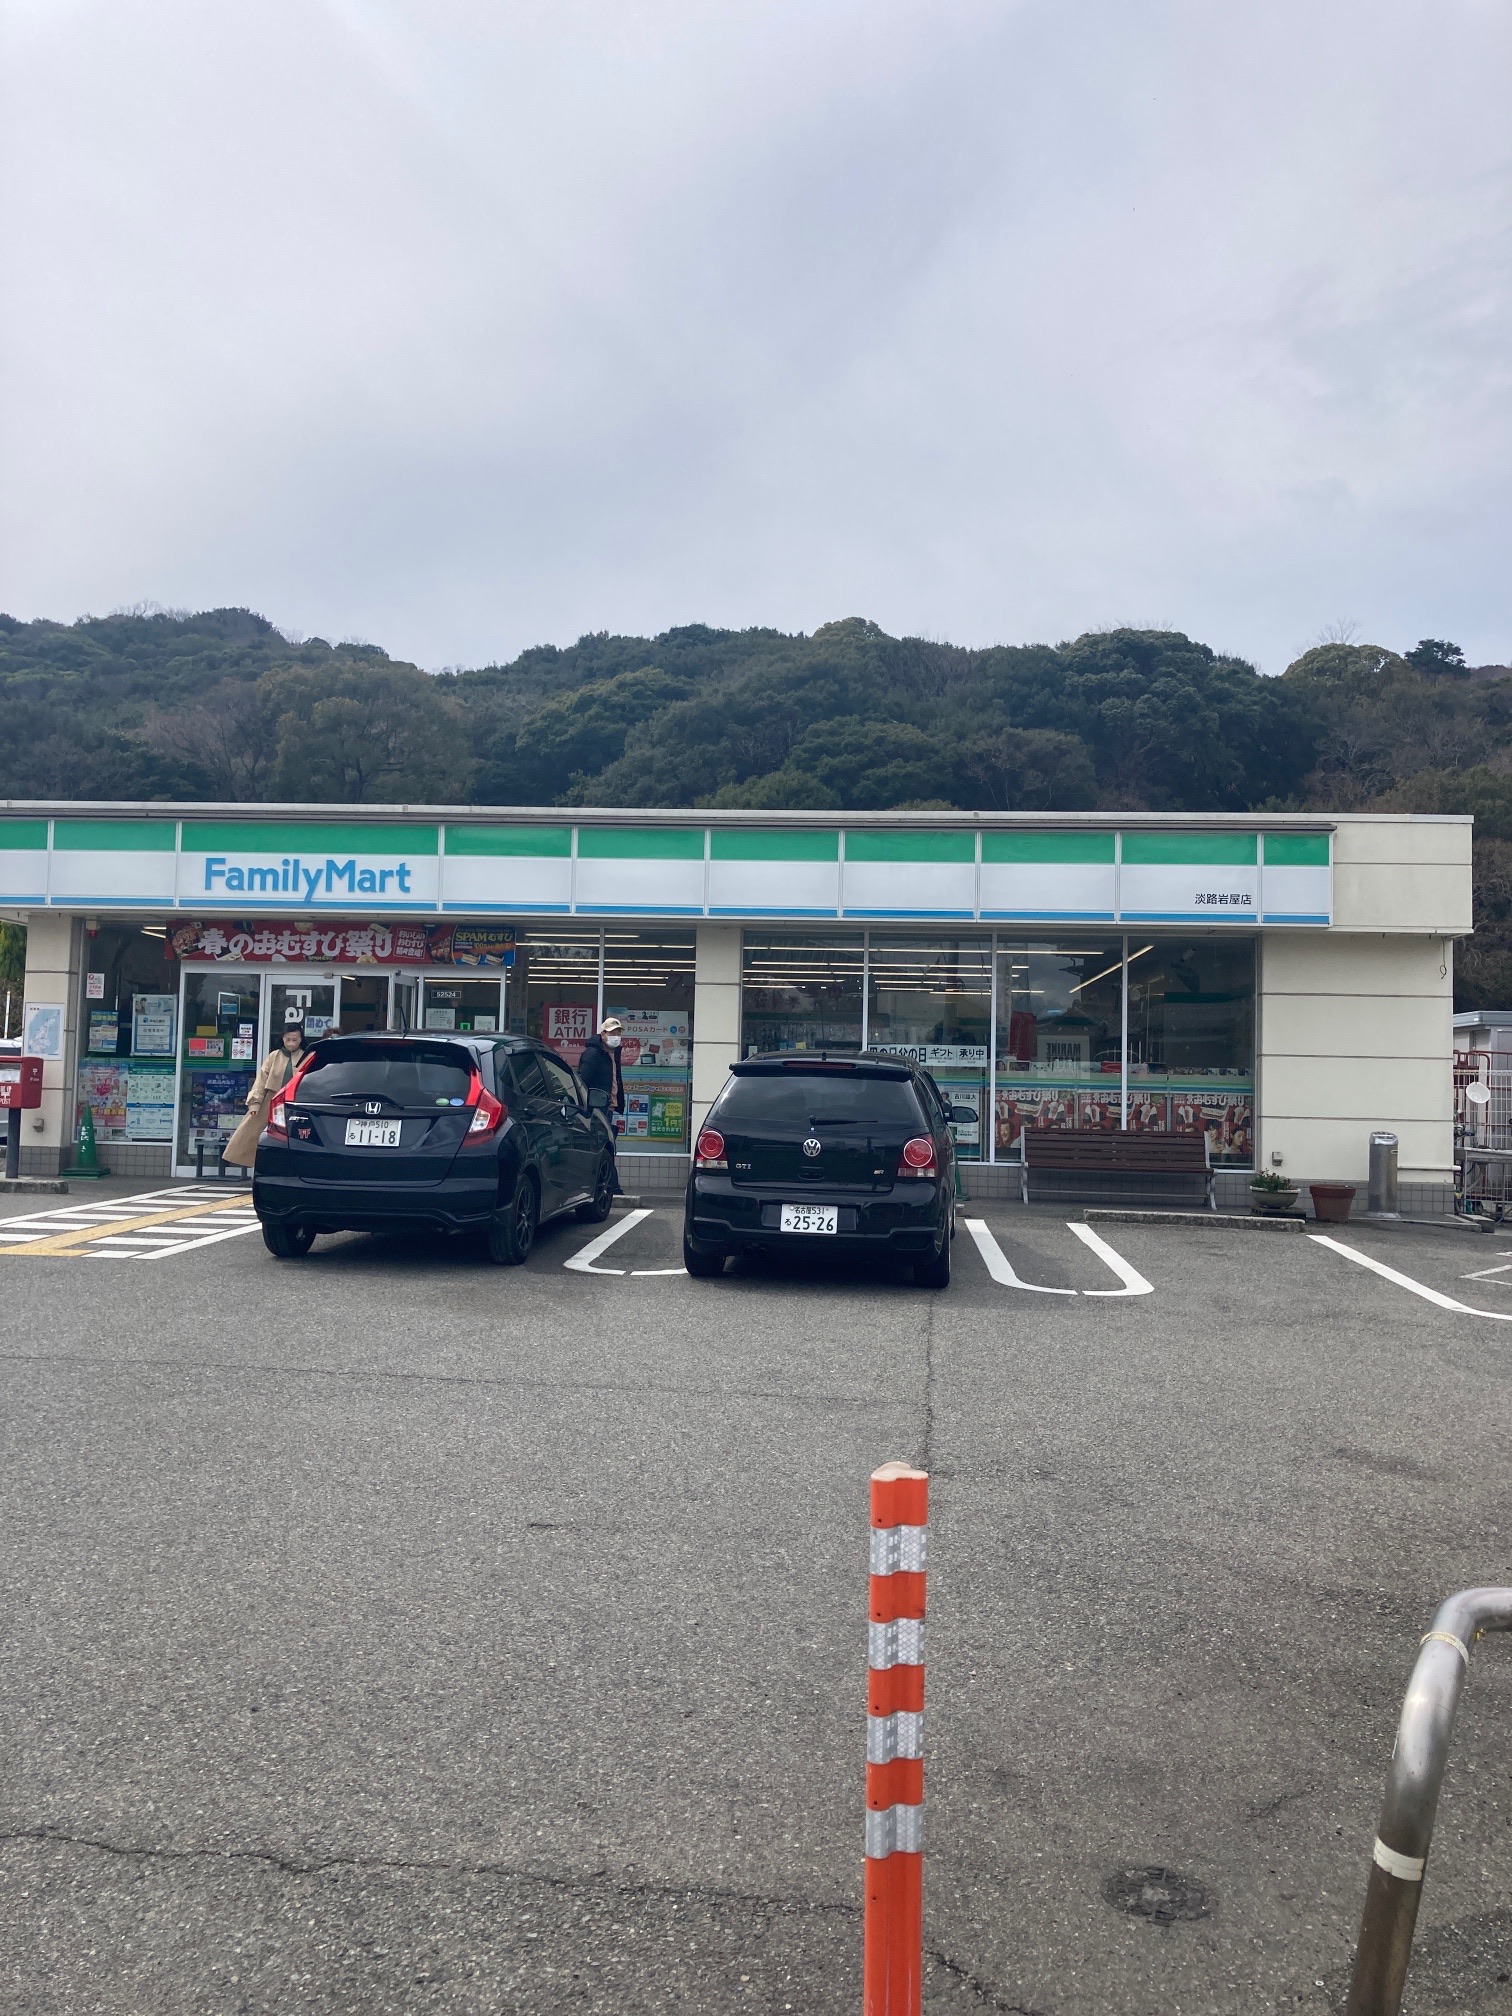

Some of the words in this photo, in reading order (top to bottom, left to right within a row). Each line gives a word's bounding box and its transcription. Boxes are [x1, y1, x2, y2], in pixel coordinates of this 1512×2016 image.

[205, 857, 411, 902] FamilyMart
[1194, 893, 1252, 905] 淡路岩屋店
[198, 927, 393, 958] 春のおむすび祭り
[554, 1009, 588, 1026] 銀行
[554, 1026, 586, 1038] ATM
[930, 1048, 953, 1057] ギフト
[959, 1048, 985, 1058] 承り中
[359, 1129, 396, 1144] 11-18
[784, 1218, 792, 1226] る
[792, 1215, 834, 1231] 25-26
